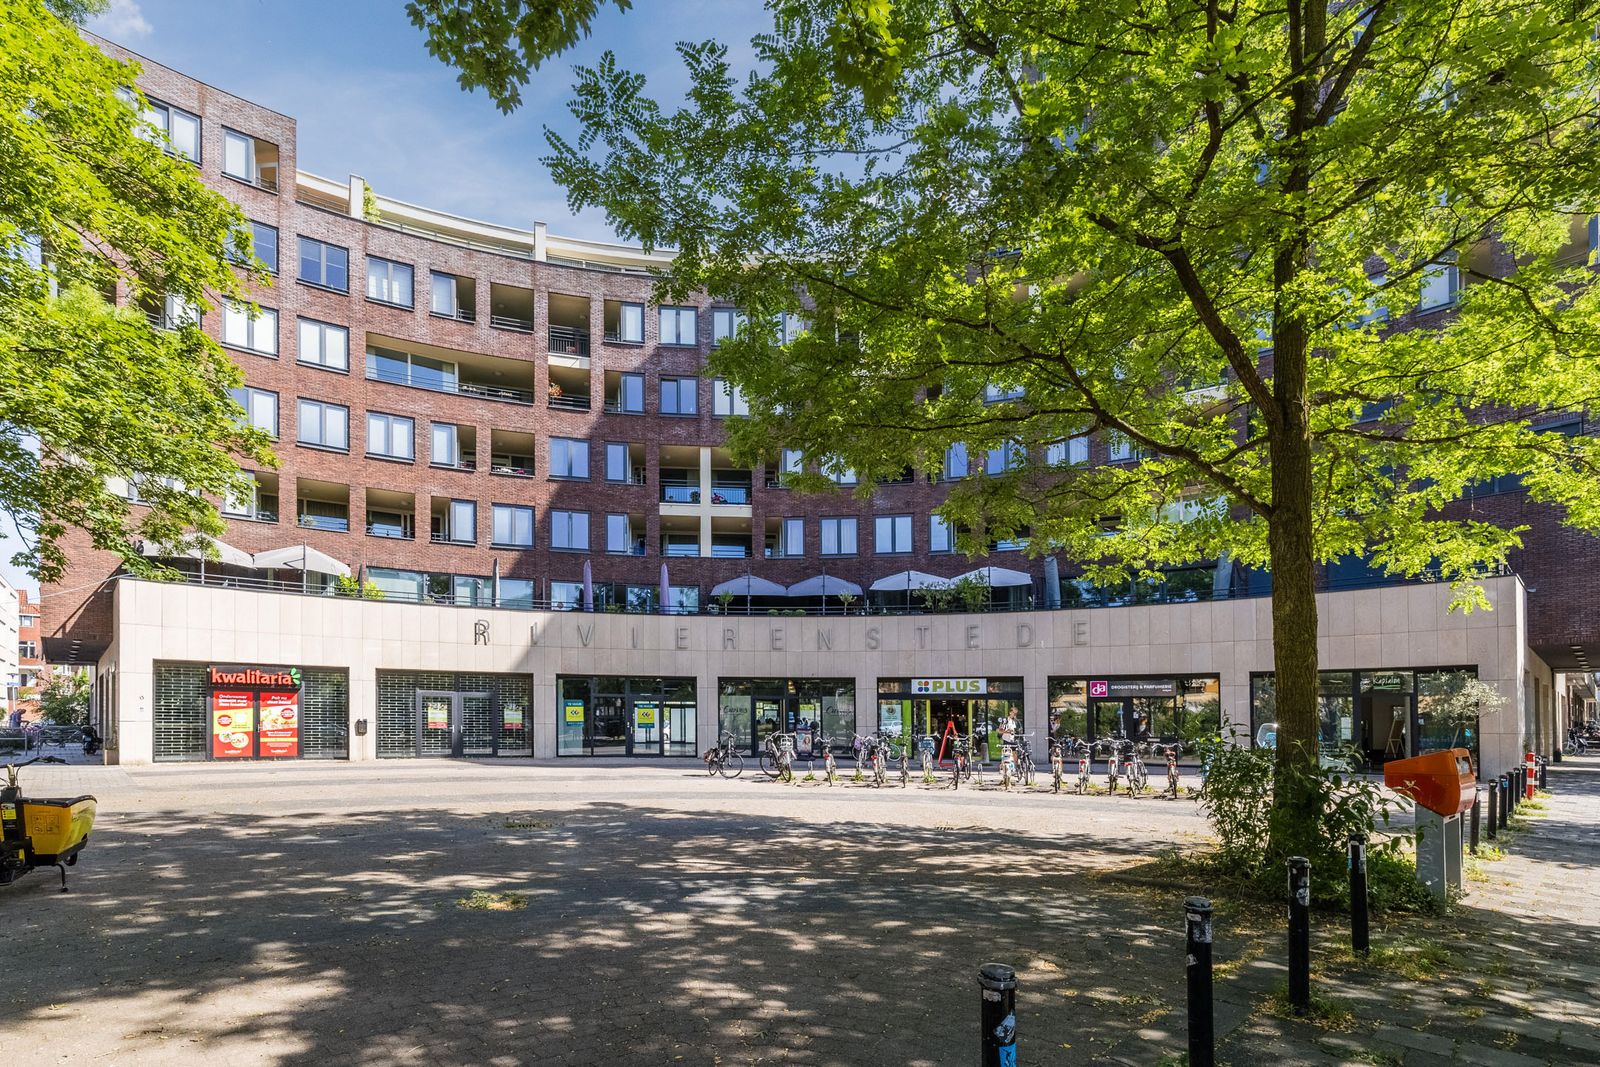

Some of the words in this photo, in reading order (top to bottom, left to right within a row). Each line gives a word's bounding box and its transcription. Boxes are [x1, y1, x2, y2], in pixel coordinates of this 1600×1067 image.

[212, 667, 292, 685] kwalitaria
[932, 680, 980, 692] PLUS
[1092, 683, 1106, 694] da
